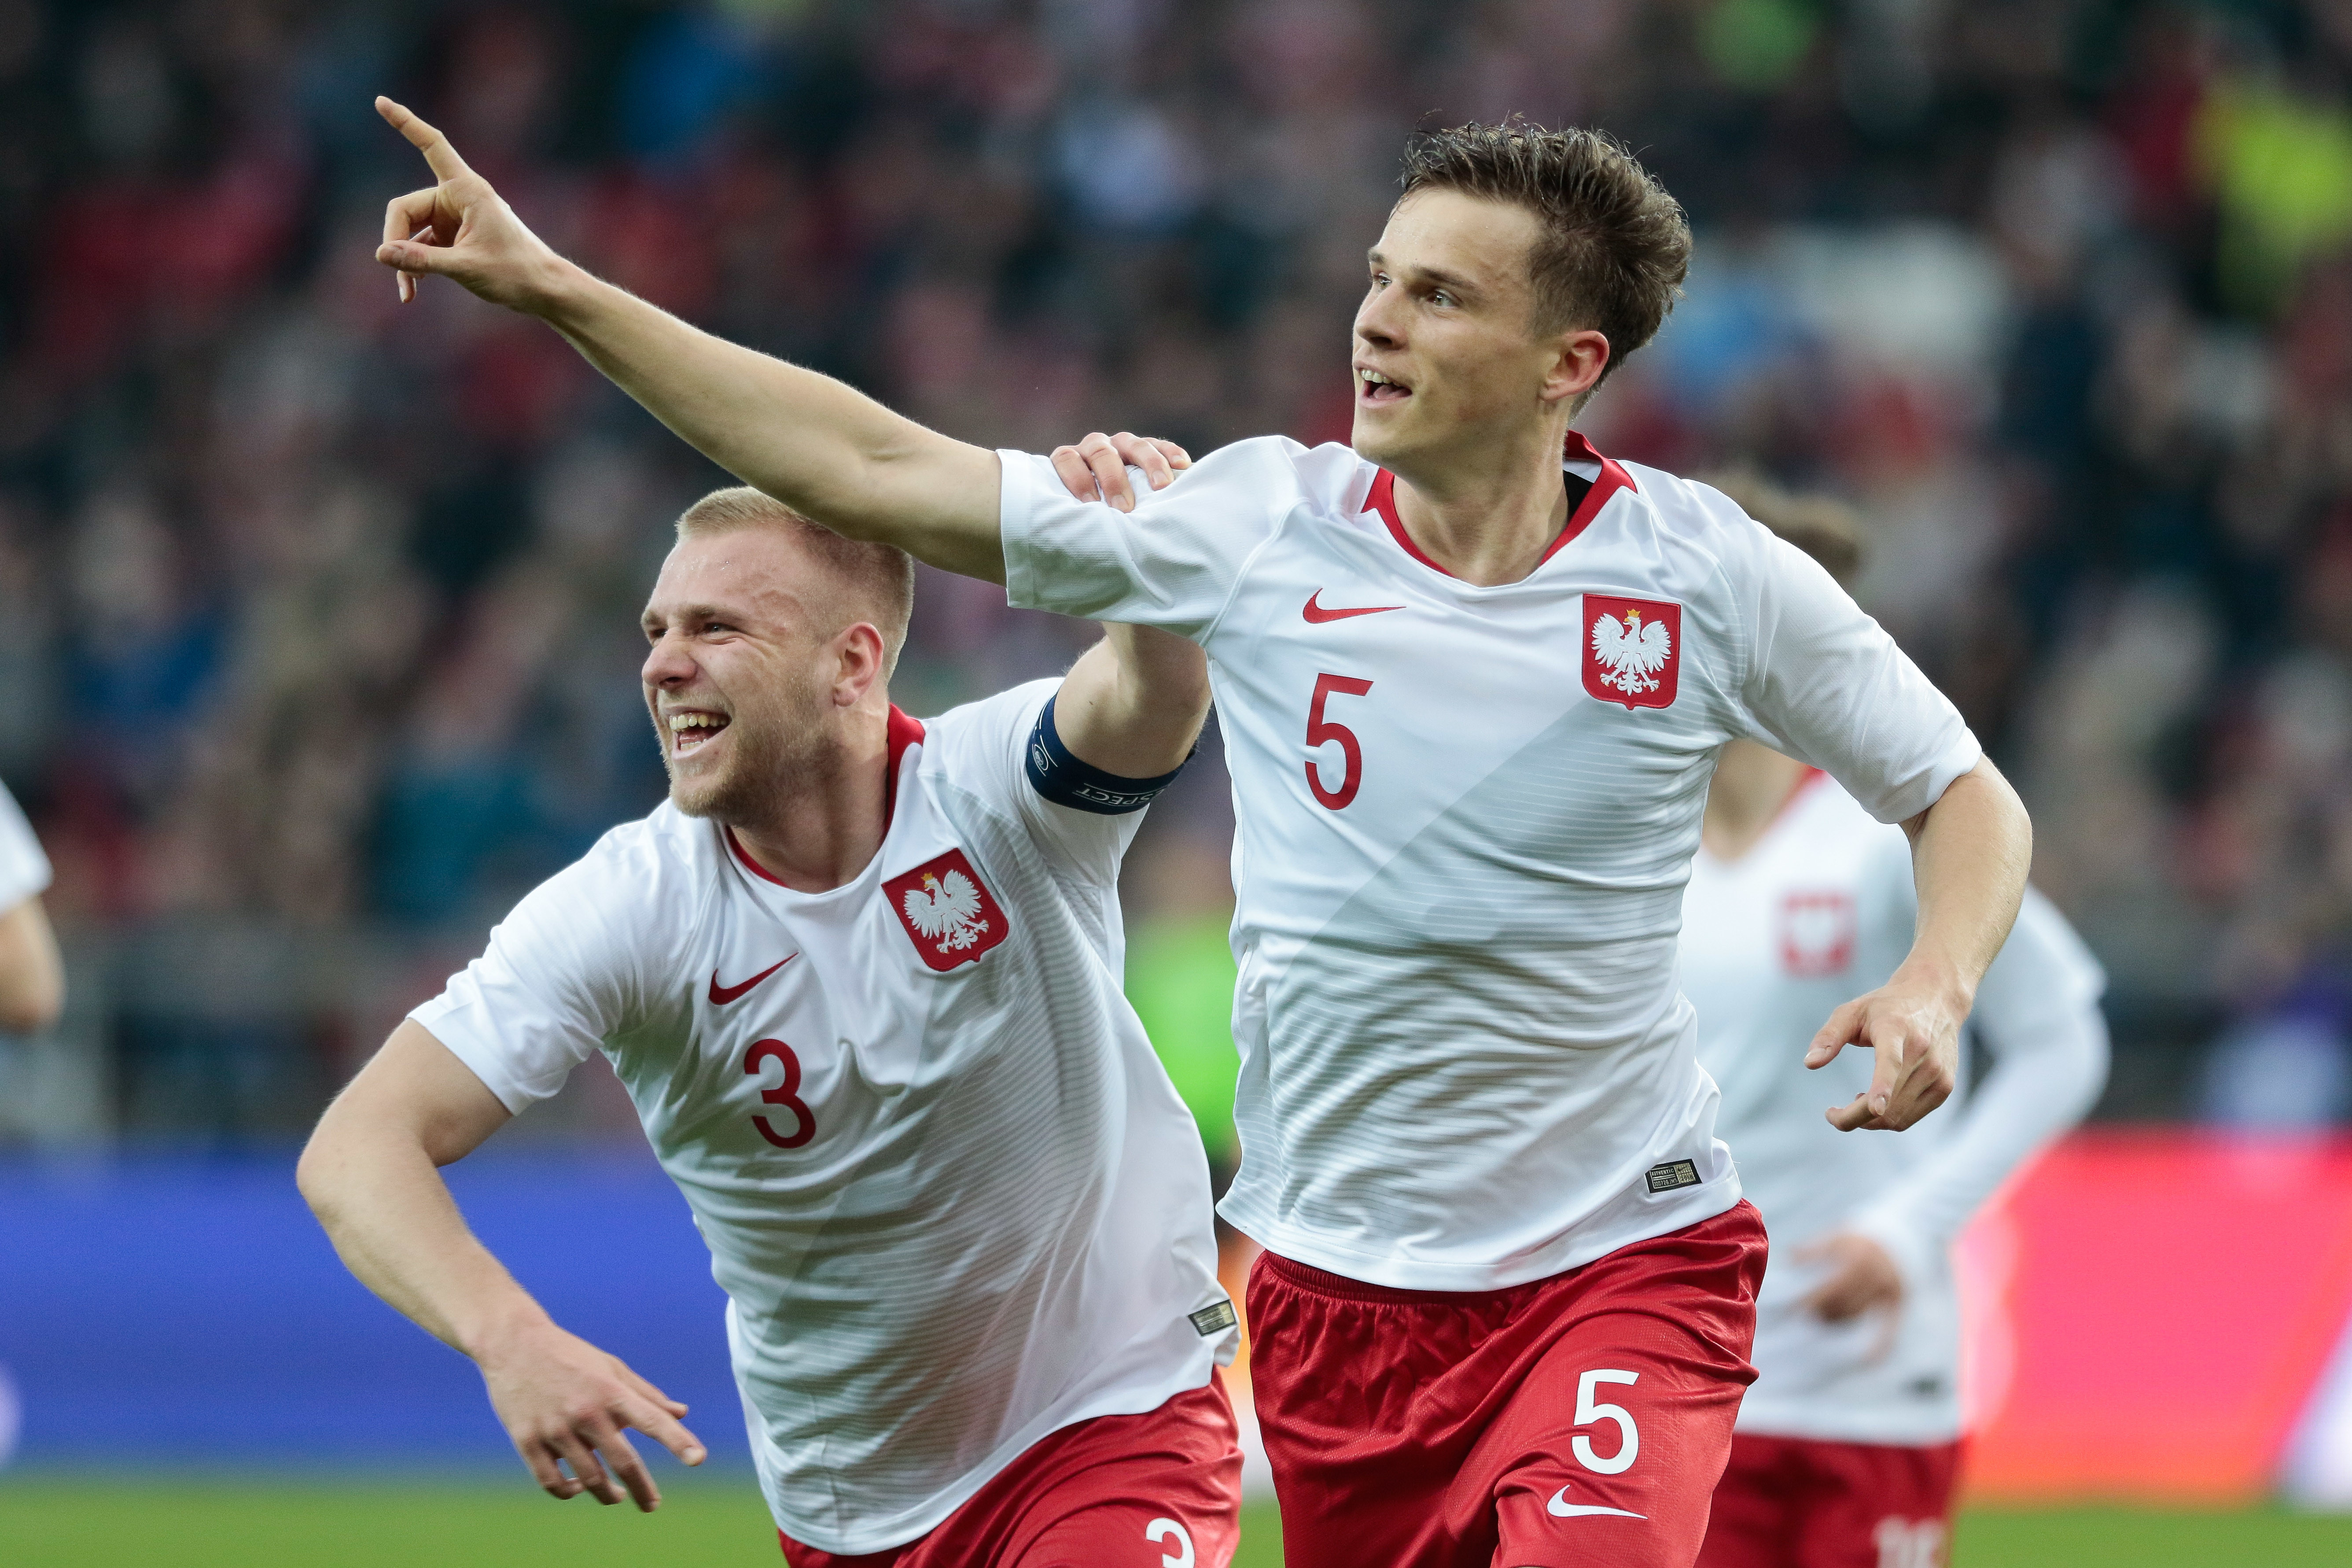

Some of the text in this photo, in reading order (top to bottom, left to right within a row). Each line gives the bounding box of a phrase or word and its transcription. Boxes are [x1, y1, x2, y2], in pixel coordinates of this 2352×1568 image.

[1305, 672, 1374, 810] 5
[744, 1038, 817, 1149] 3
[1571, 1368, 1640, 1475] 5
[1145, 1517, 1196, 1568] 3
